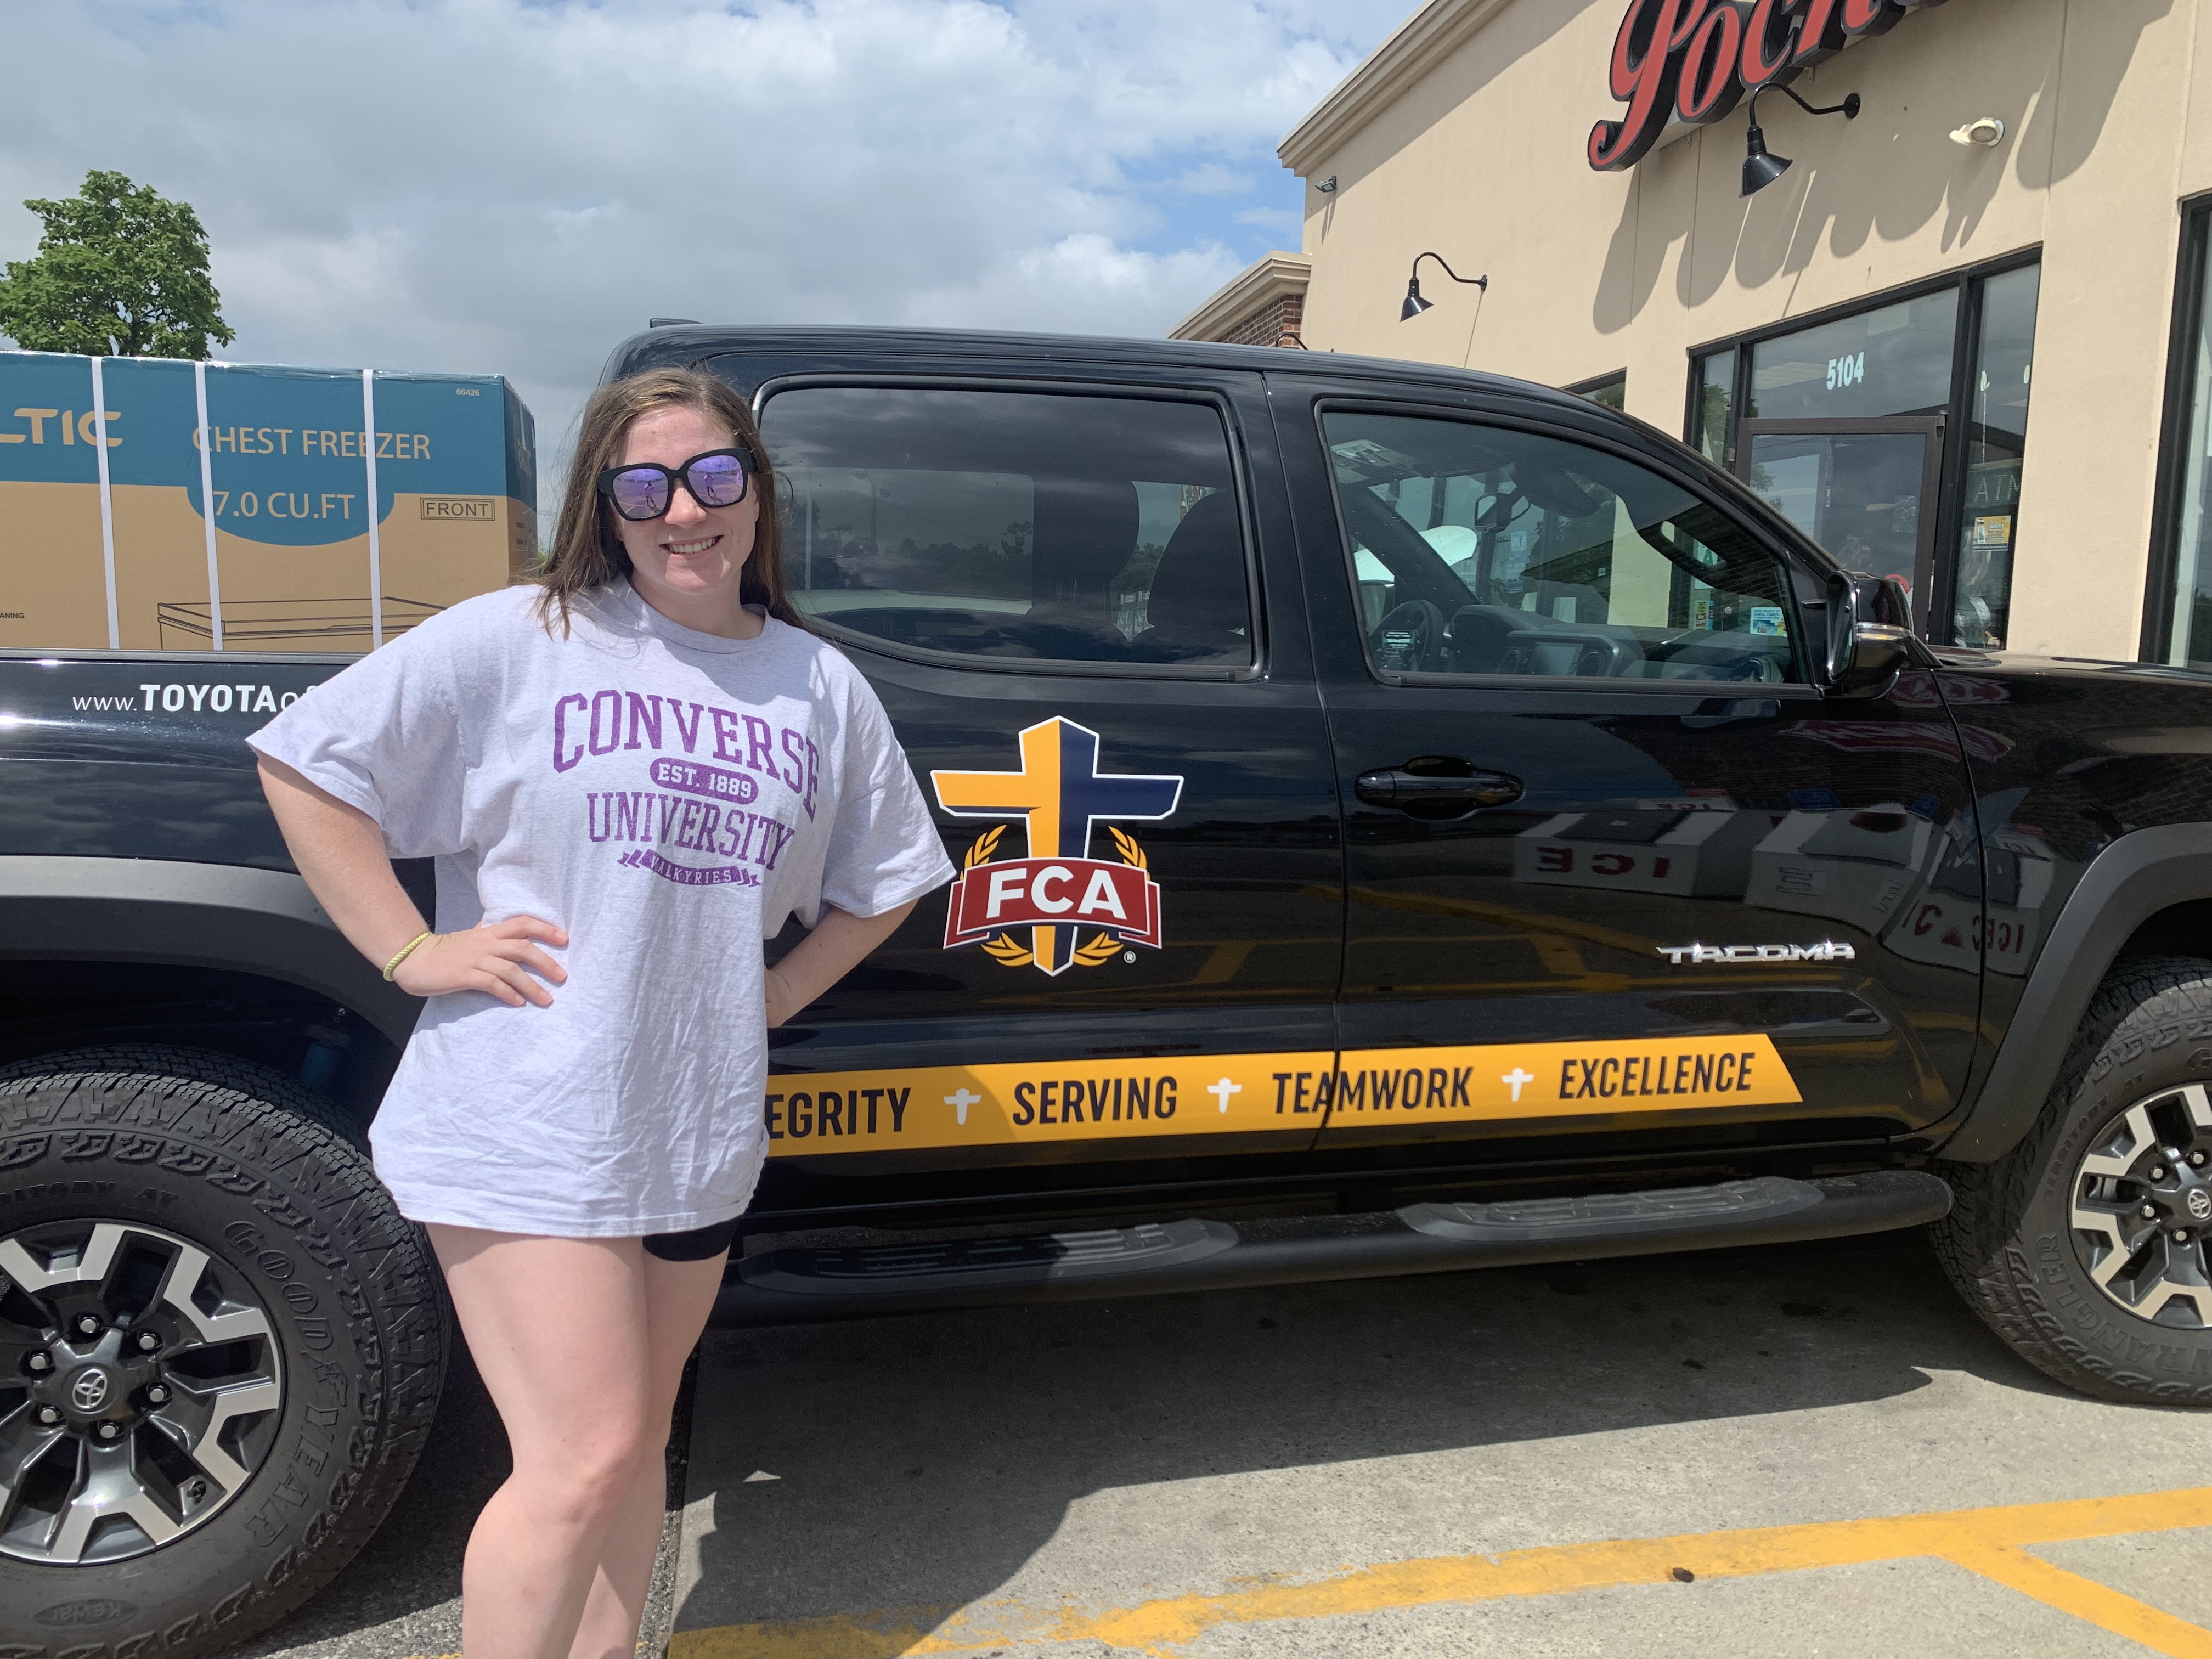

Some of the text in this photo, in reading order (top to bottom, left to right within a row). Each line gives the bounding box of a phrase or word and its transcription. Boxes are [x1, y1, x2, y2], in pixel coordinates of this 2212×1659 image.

[1826, 352, 1865, 391] 5104
[456, 388, 480, 396] 66426
[193, 426, 431, 460] CHEST FREEZER
[213, 490, 355, 520] 7.0 CU.FT
[426, 503, 489, 517] FRONT
[554, 689, 820, 823] CONVERSE
[658, 764, 752, 798] EST. 1889
[587, 792, 795, 871] UNIVERSITY
[651, 855, 732, 884] VALKYRIES
[986, 866, 1127, 920] FCA
[1655, 939, 1856, 963] TACOMA
[764, 1052, 1756, 1139] EGRITY SERVING TEAMWORK EXCELLENCE
[222, 1220, 347, 1547] GOODYEAR
